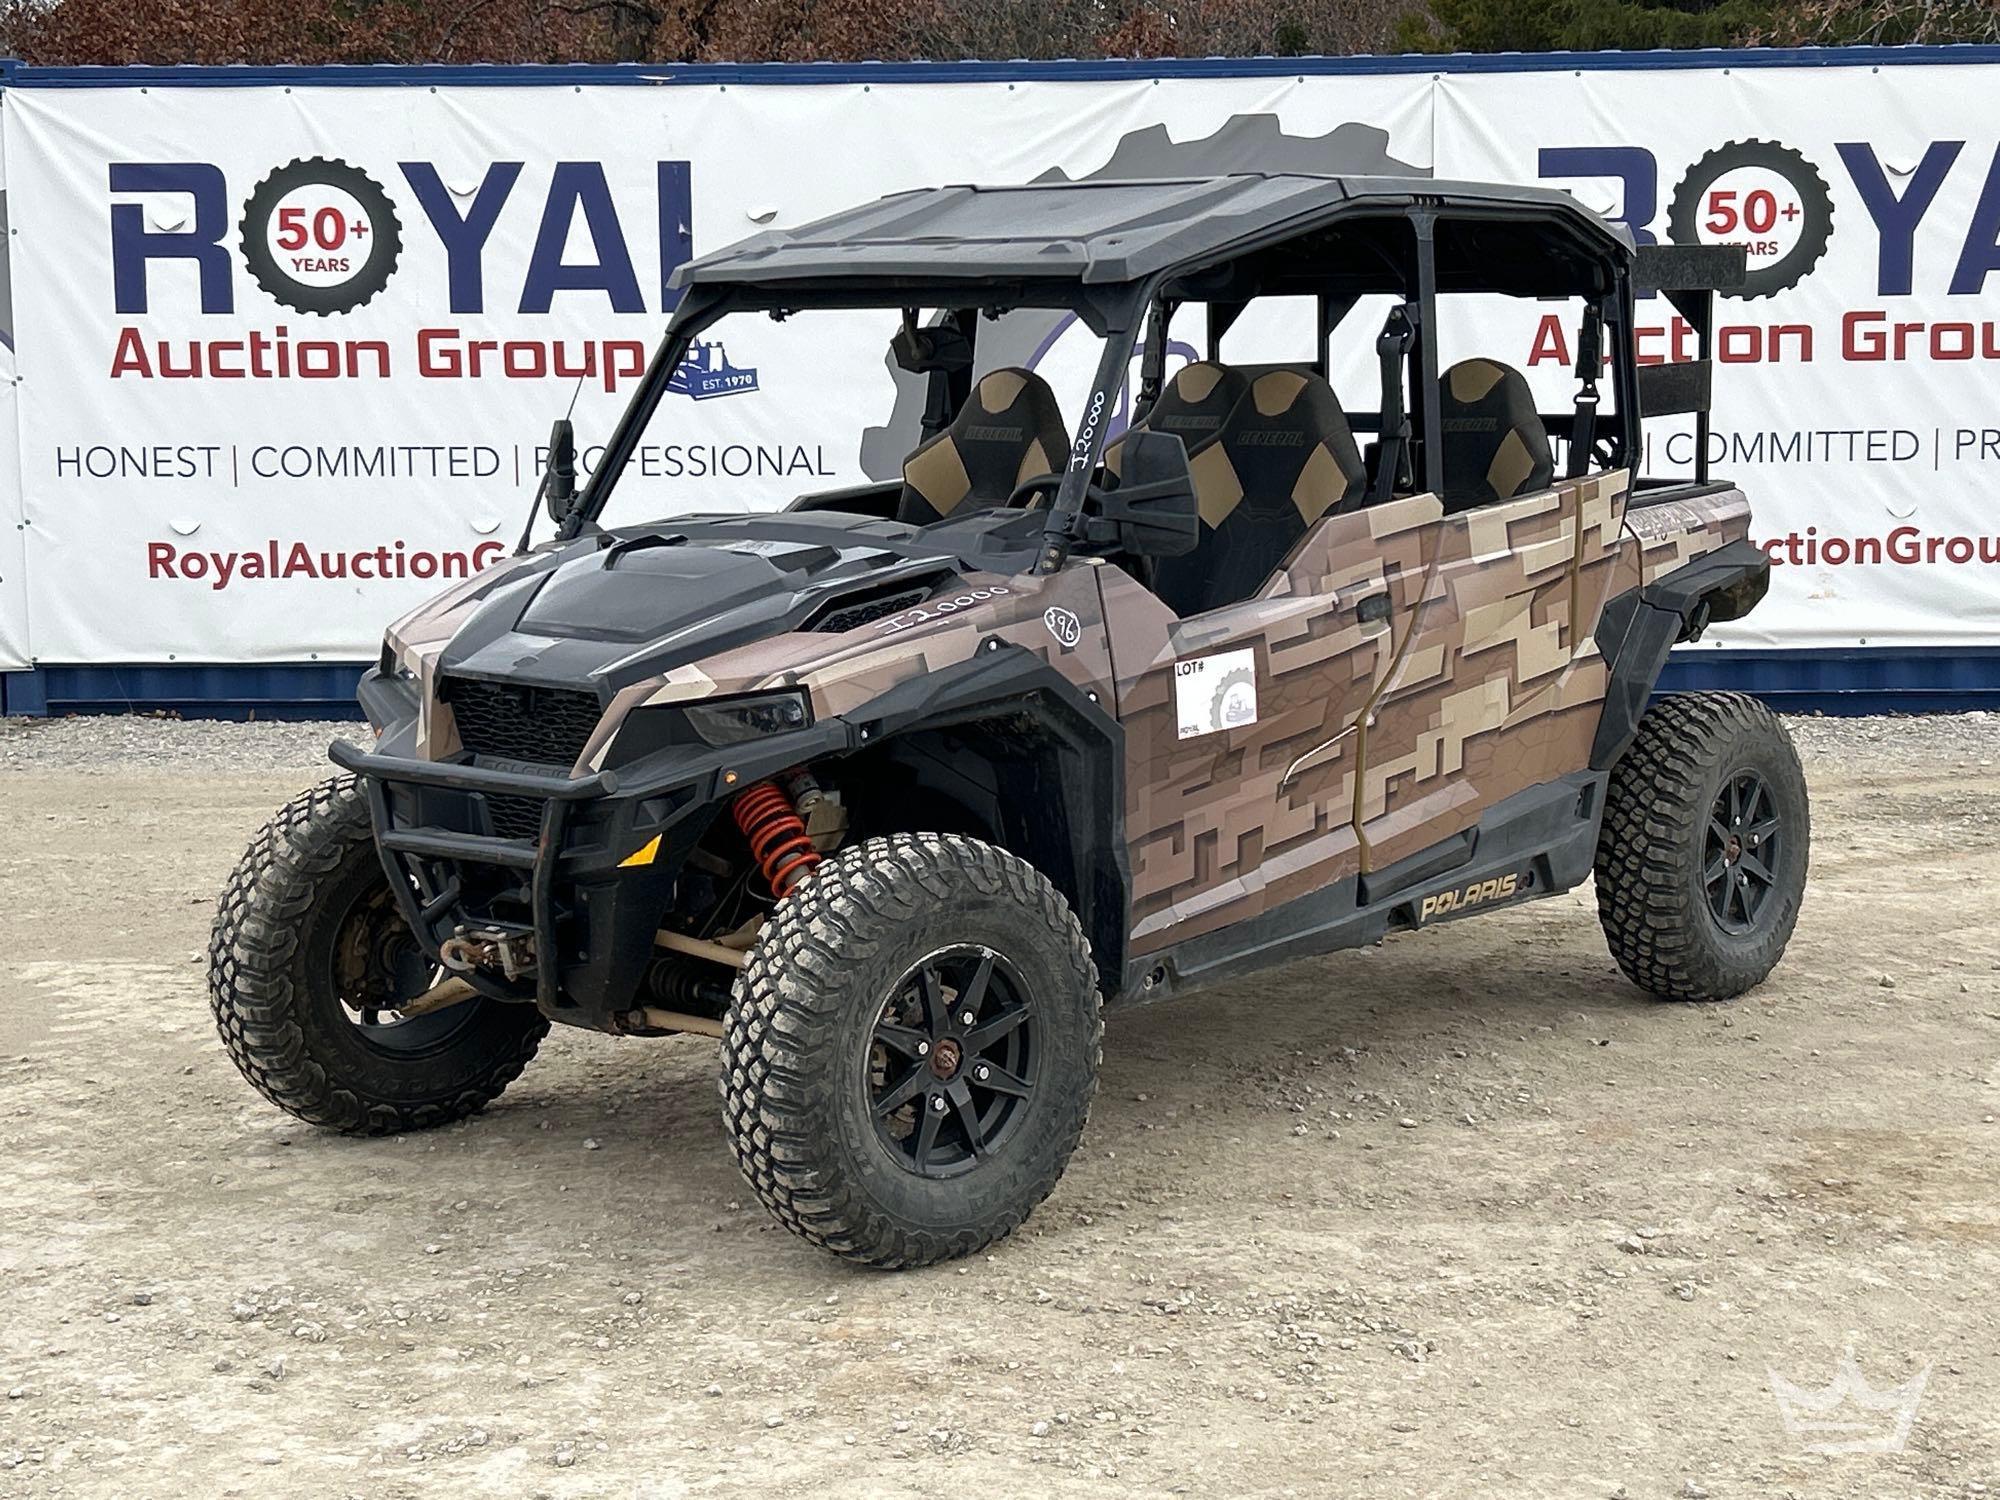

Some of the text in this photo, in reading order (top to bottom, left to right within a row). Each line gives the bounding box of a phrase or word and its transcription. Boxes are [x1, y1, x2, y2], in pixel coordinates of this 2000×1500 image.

[276, 206, 370, 252] 50+
[1705, 189, 1801, 234] 50+
[290, 257, 350, 273] YEARS
[1527, 313, 1813, 366] Acton
[110, 326, 645, 393] Auction Group
[702, 374, 753, 390] EST. 1970
[1237, 431, 1305, 447] GENERAL
[57, 446, 221, 478] HONEST
[251, 446, 501, 478] COMMITTED
[1176, 661, 1204, 676] LOT#
[1420, 873, 1518, 922] POLARIS
